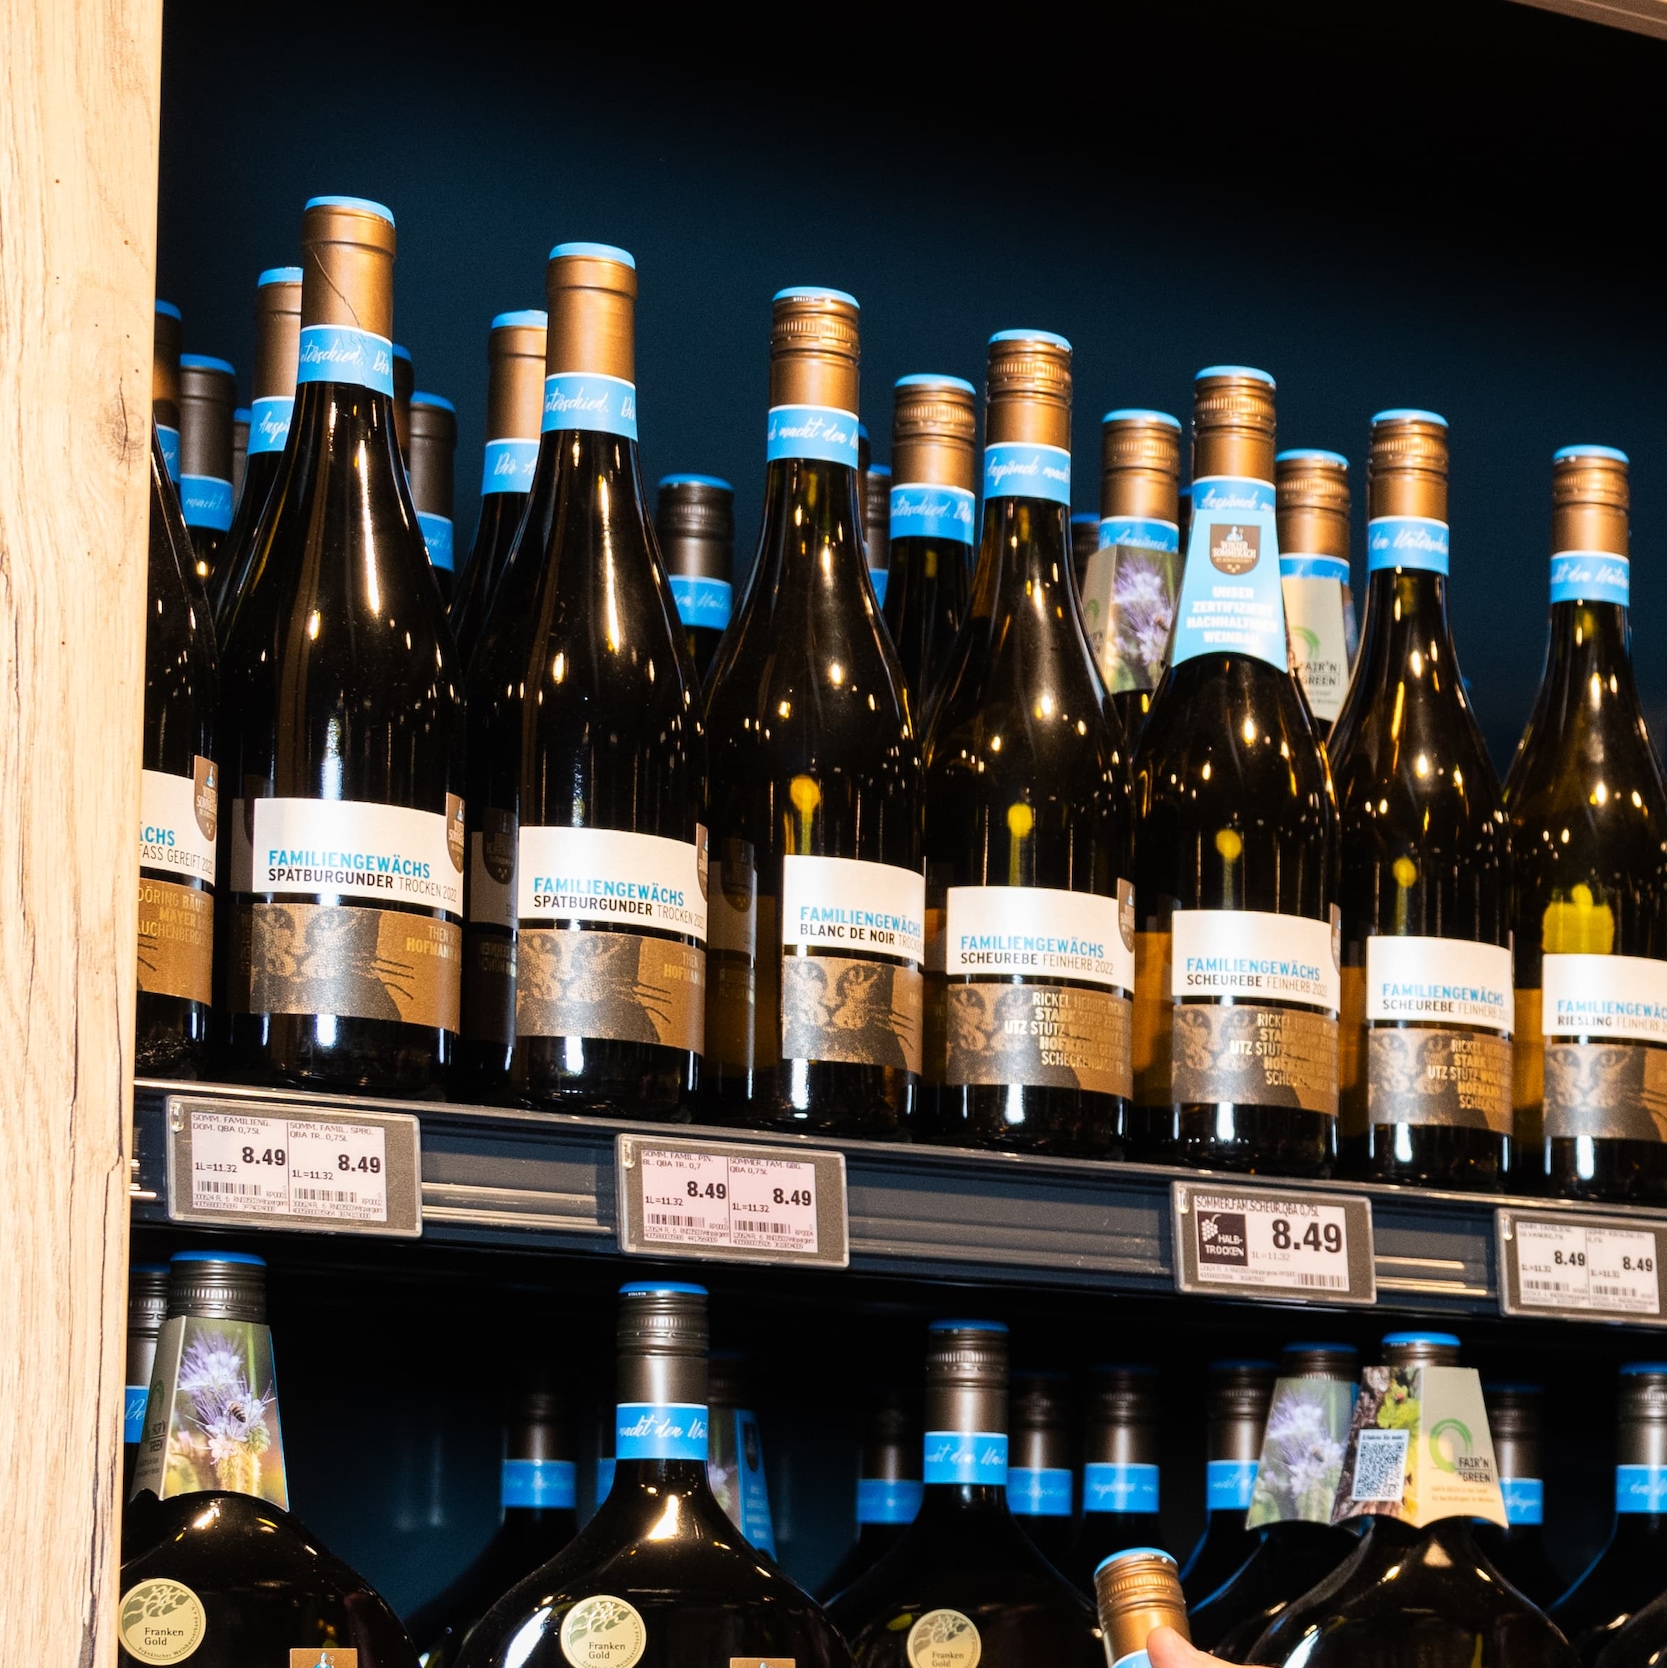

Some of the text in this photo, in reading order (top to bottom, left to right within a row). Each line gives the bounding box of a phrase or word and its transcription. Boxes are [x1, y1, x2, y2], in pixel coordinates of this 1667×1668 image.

[268, 850, 430, 879] FAMILIENGEWÄCHS
[268, 867, 440, 898] SPÄTBURGUNDER TROCKEN
[534, 878, 684, 907] FAMILIENGEWÄCHS
[534, 893, 653, 915] SPÄTBURGUNDER
[800, 924, 895, 945] BLANC DE NOIR
[961, 936, 1104, 959] FAMILIENGEWÄCHS
[961, 951, 1092, 973] SCHEUREBE FEINHERB
[1187, 959, 1320, 981] FAMILIENGEWÄCHS
[1187, 974, 1262, 988] SCHEUREBE
[1383, 1000, 1454, 1013] SCHEUREBE
[1558, 1016, 1612, 1027] RIESLING
[217, 1124, 235, 1133] QBA
[238, 1126, 261, 1135] 0,75L
[242, 1147, 286, 1166] 8.49
[338, 1155, 381, 1174] 8.49
[687, 1181, 727, 1199] 8.49
[773, 1188, 812, 1206] 8.49
[1218, 1233, 1243, 1244] HALB-
[1272, 1219, 1342, 1253] 8.49
[1205, 1245, 1244, 1256] TROCKEN
[1554, 1251, 1585, 1266] 8.49
[1623, 1256, 1653, 1272] 8.49
[144, 1627, 184, 1636] Franken
[144, 1637, 167, 1646] Gold
[588, 1642, 626, 1651] Franken
[588, 1651, 610, 1660] Gold
